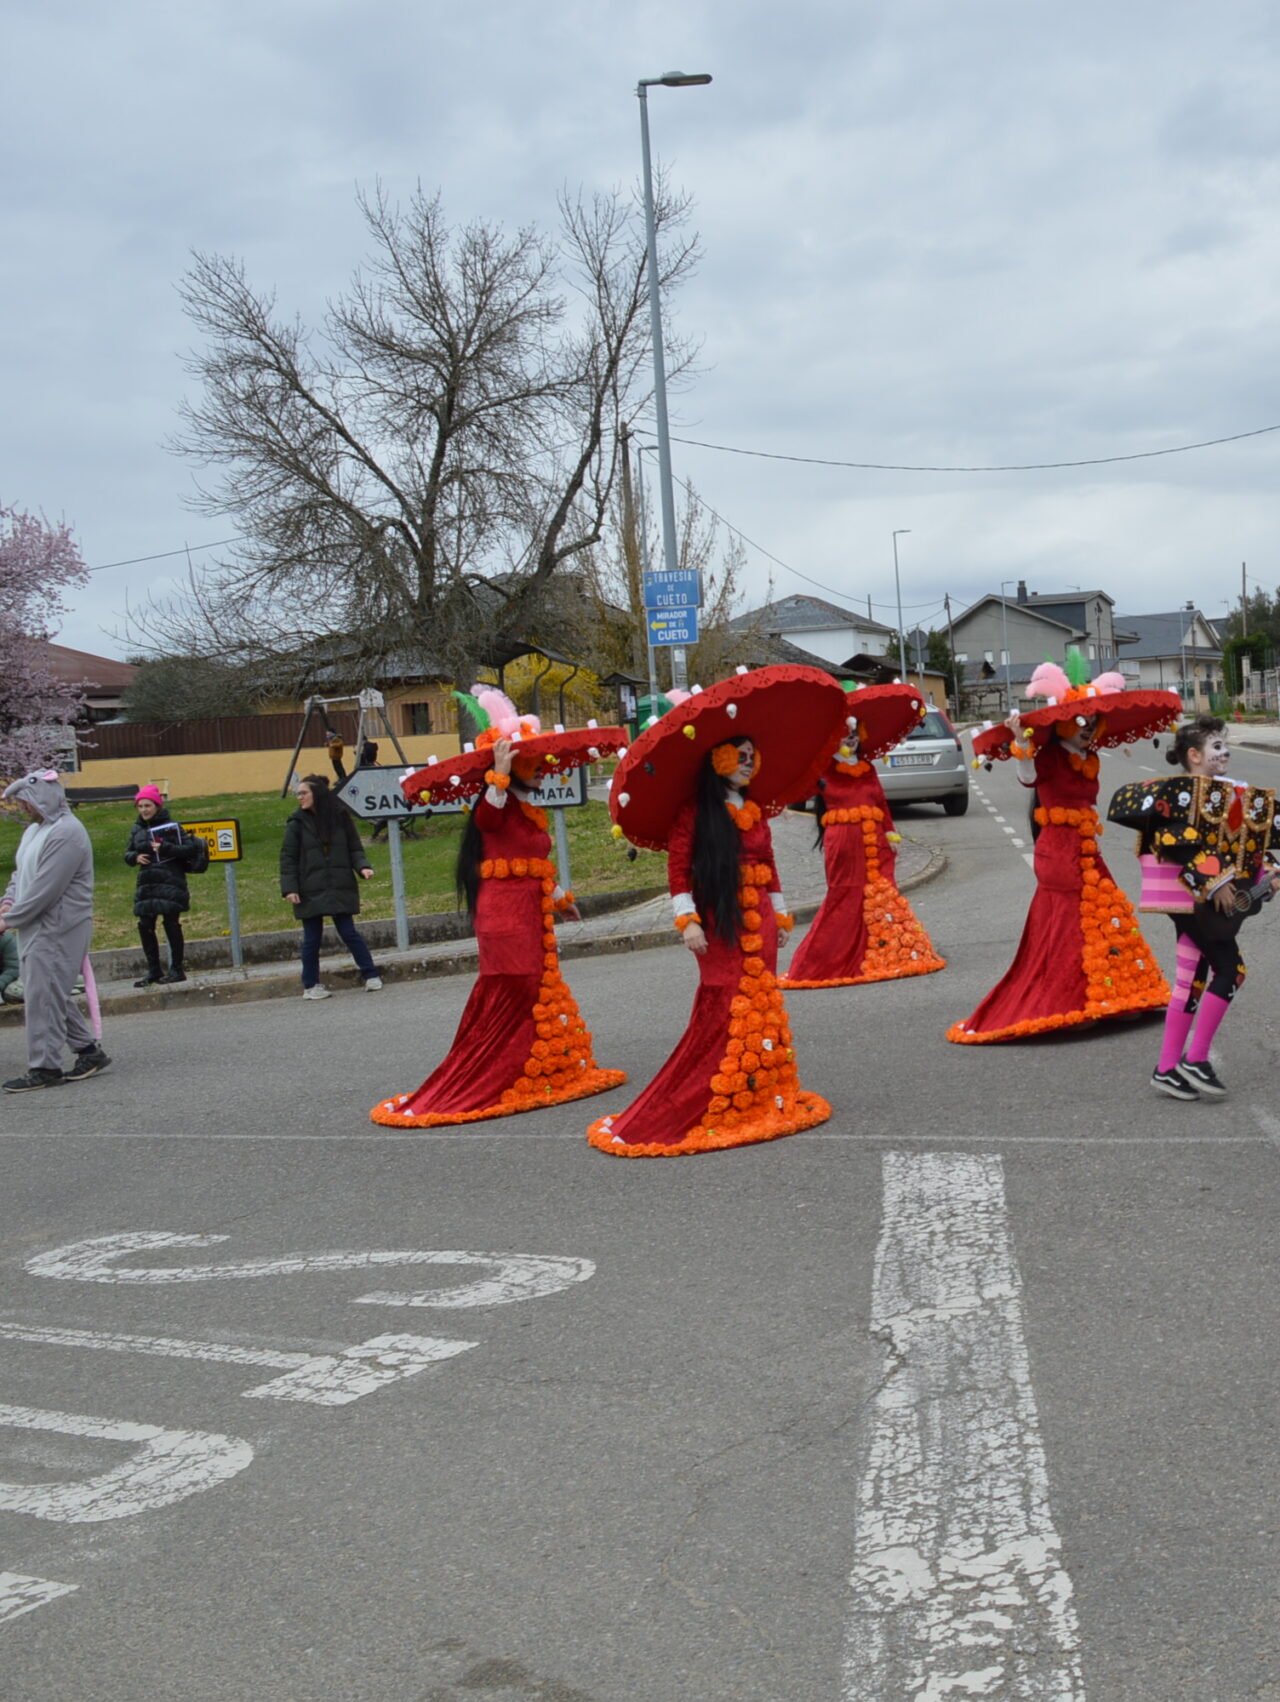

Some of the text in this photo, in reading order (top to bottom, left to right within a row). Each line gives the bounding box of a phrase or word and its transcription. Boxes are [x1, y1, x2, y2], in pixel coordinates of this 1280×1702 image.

[657, 594, 687, 606] CUETO
[657, 611, 687, 620] MIRADOR
[658, 630, 688, 640] CUETO
[534, 788, 575, 800] MATA
[365, 795, 407, 811] SAN
